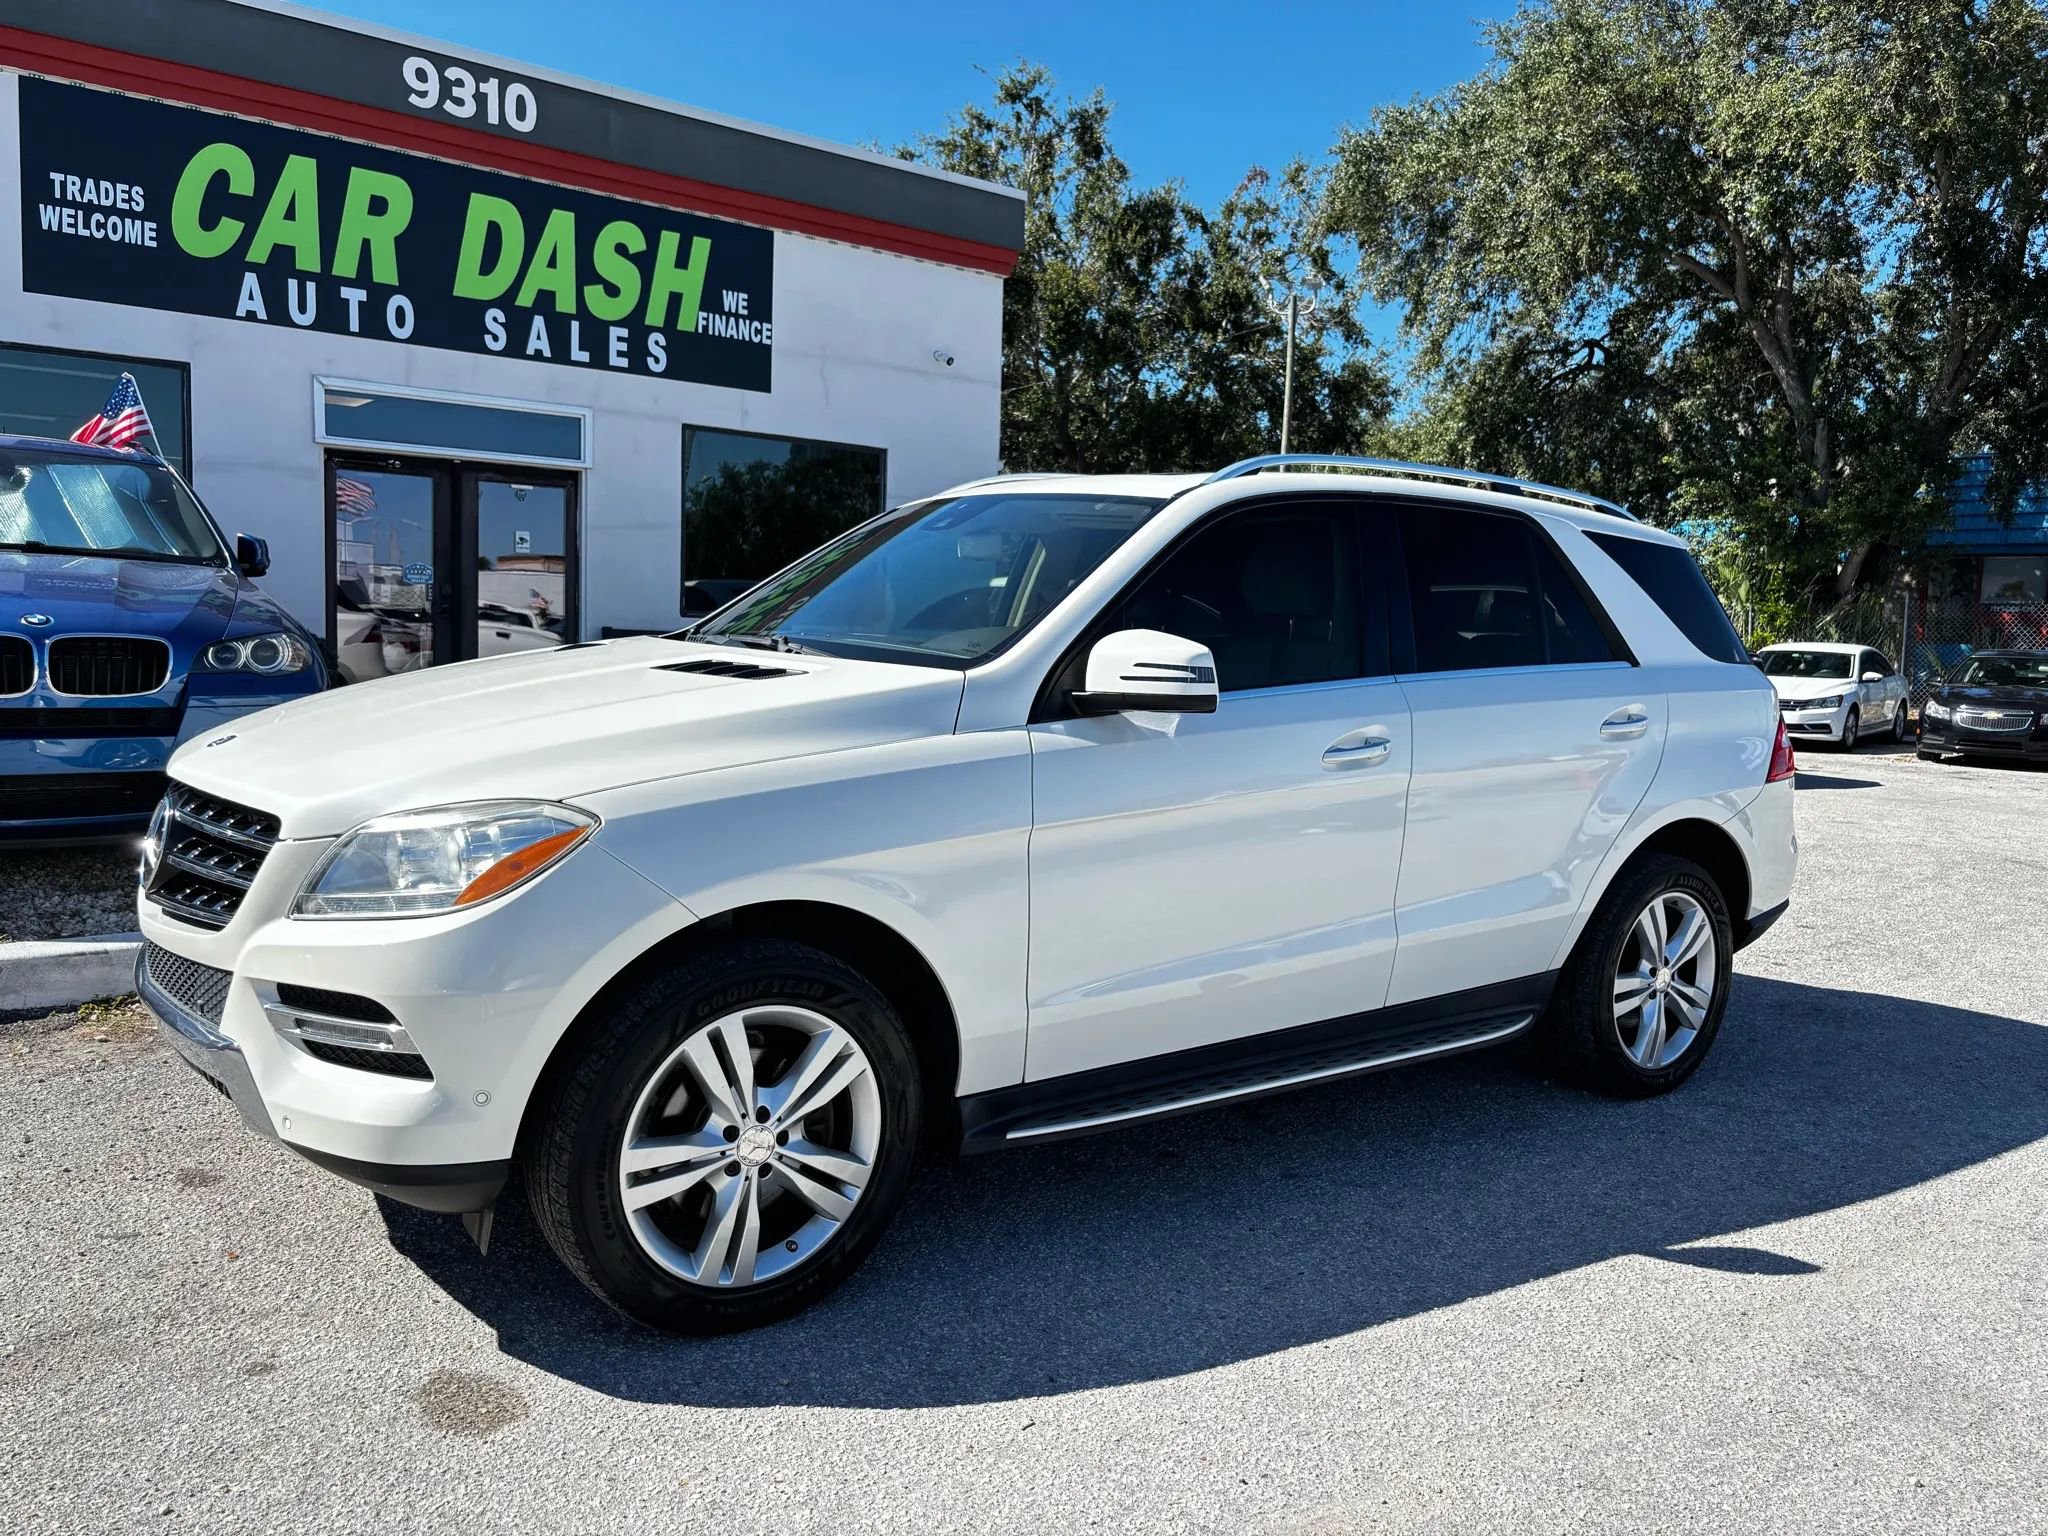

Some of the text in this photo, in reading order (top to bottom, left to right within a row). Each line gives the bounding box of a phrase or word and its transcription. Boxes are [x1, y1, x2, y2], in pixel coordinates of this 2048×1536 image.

[402, 56, 538, 133] 9310
[49, 172, 145, 212] TRADES
[38, 204, 158, 248] WELCOME
[171, 143, 712, 333] CAR DASH
[235, 272, 668, 374] AUTO SALES
[722, 289, 749, 316] WE
[697, 311, 773, 345] FINANCE
[696, 978, 825, 1017] GOODYEAR
